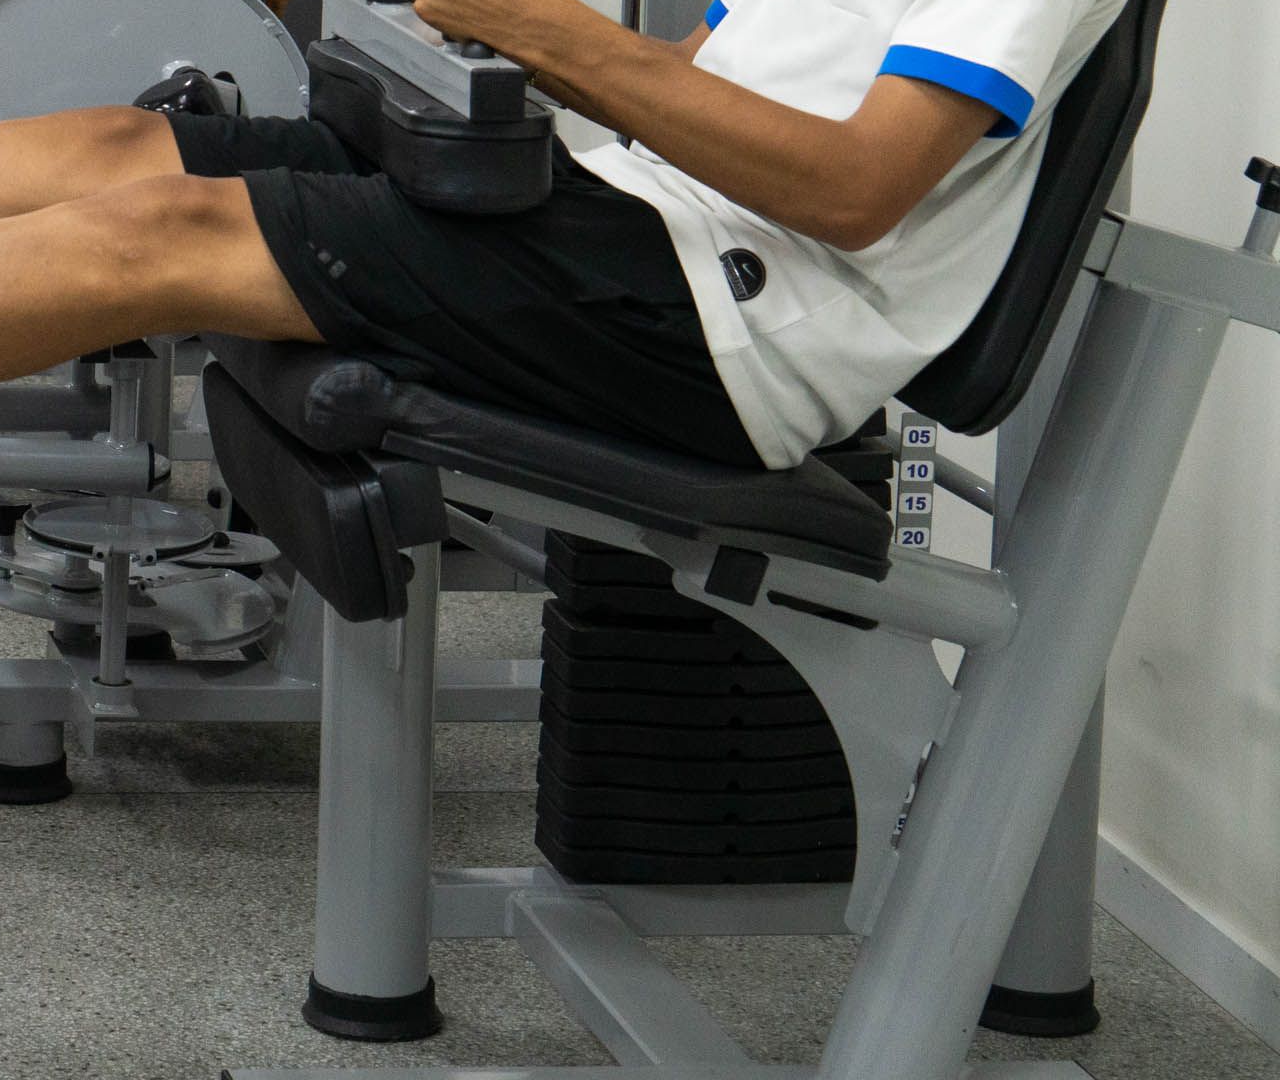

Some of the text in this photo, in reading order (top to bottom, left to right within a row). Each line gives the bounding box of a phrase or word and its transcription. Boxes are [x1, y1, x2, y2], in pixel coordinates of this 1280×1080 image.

[908, 429, 930, 444] 05
[907, 463, 928, 478] 10
[905, 496, 926, 511] 15
[902, 530, 924, 545] 20
